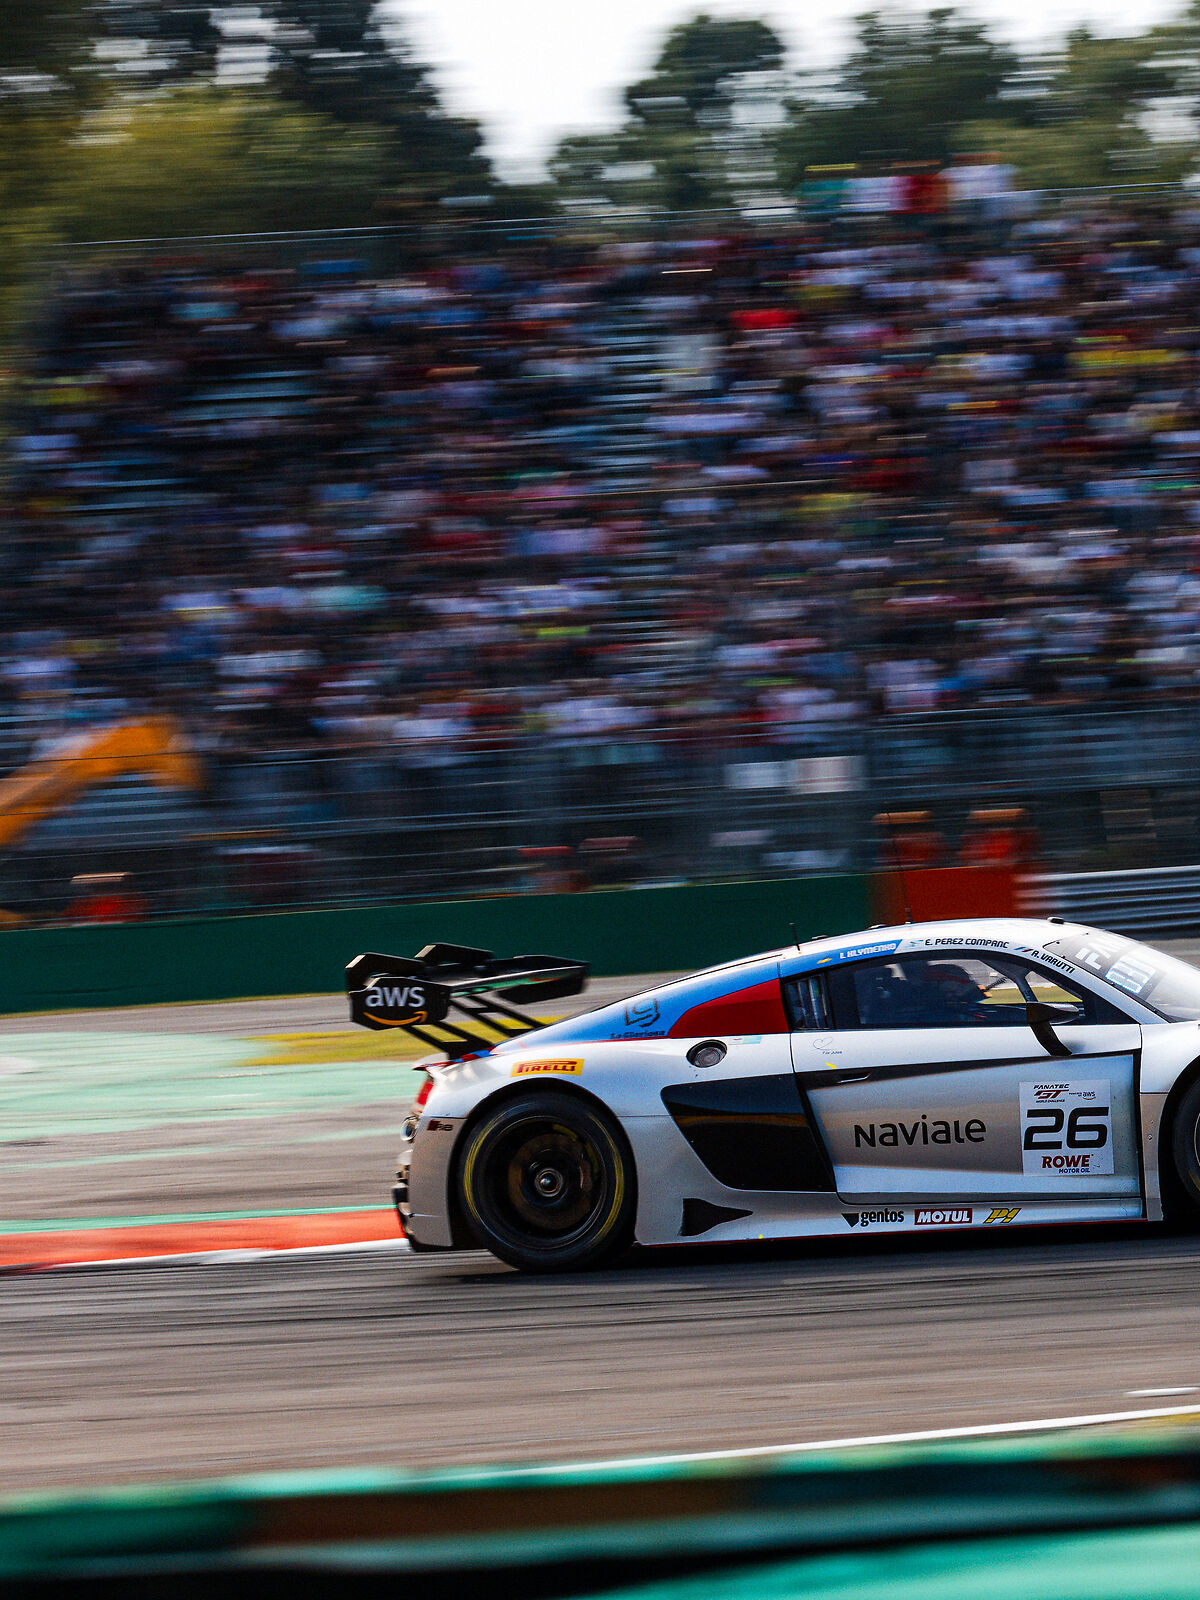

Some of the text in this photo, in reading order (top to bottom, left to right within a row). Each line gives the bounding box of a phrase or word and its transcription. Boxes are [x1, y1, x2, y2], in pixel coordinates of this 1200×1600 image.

[924, 938, 933, 946] E.
[934, 937, 964, 946] PEREZ
[1030, 950, 1076, 974] R. VARUTTI
[364, 986, 426, 1008] aws
[517, 1060, 578, 1074] PIRELLI
[1033, 1089, 1070, 1100] GT
[1023, 1106, 1110, 1151] 26
[1041, 1154, 1091, 1169] ROWE
[860, 1208, 905, 1227] gentos
[917, 1210, 971, 1224] MOTUL
